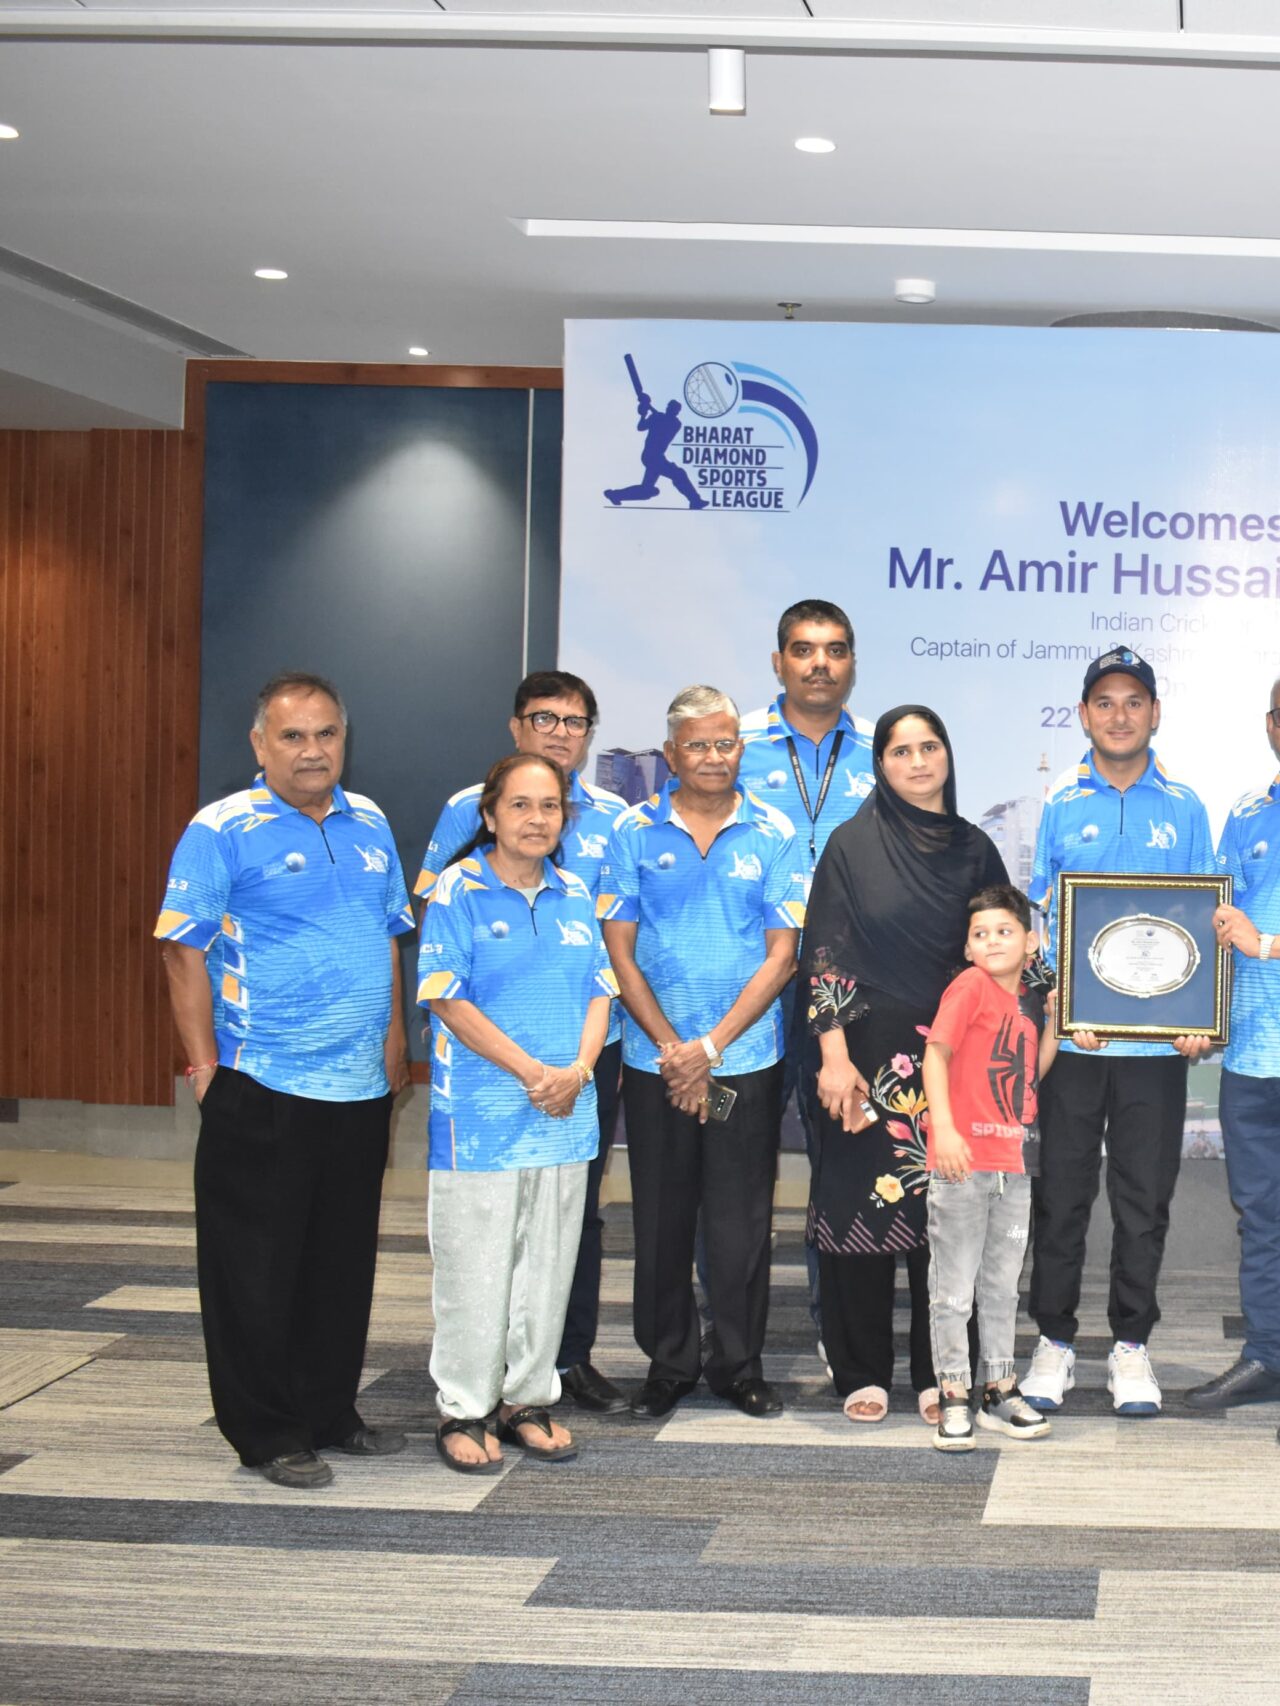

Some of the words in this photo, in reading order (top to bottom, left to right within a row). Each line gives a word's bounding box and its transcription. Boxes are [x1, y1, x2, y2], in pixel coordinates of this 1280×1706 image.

[683, 425, 754, 445] BHARAT
[682, 446, 767, 467] DIAMOND
[697, 468, 767, 488] SPORTS
[711, 489, 784, 509] LEAGUE
[888, 546, 963, 591] Mr.
[978, 549, 1099, 594] Amir
[1090, 611, 1154, 633] Indian
[909, 636, 991, 661] Captain
[996, 639, 1017, 660] of
[1022, 640, 1100, 661] Jammu
